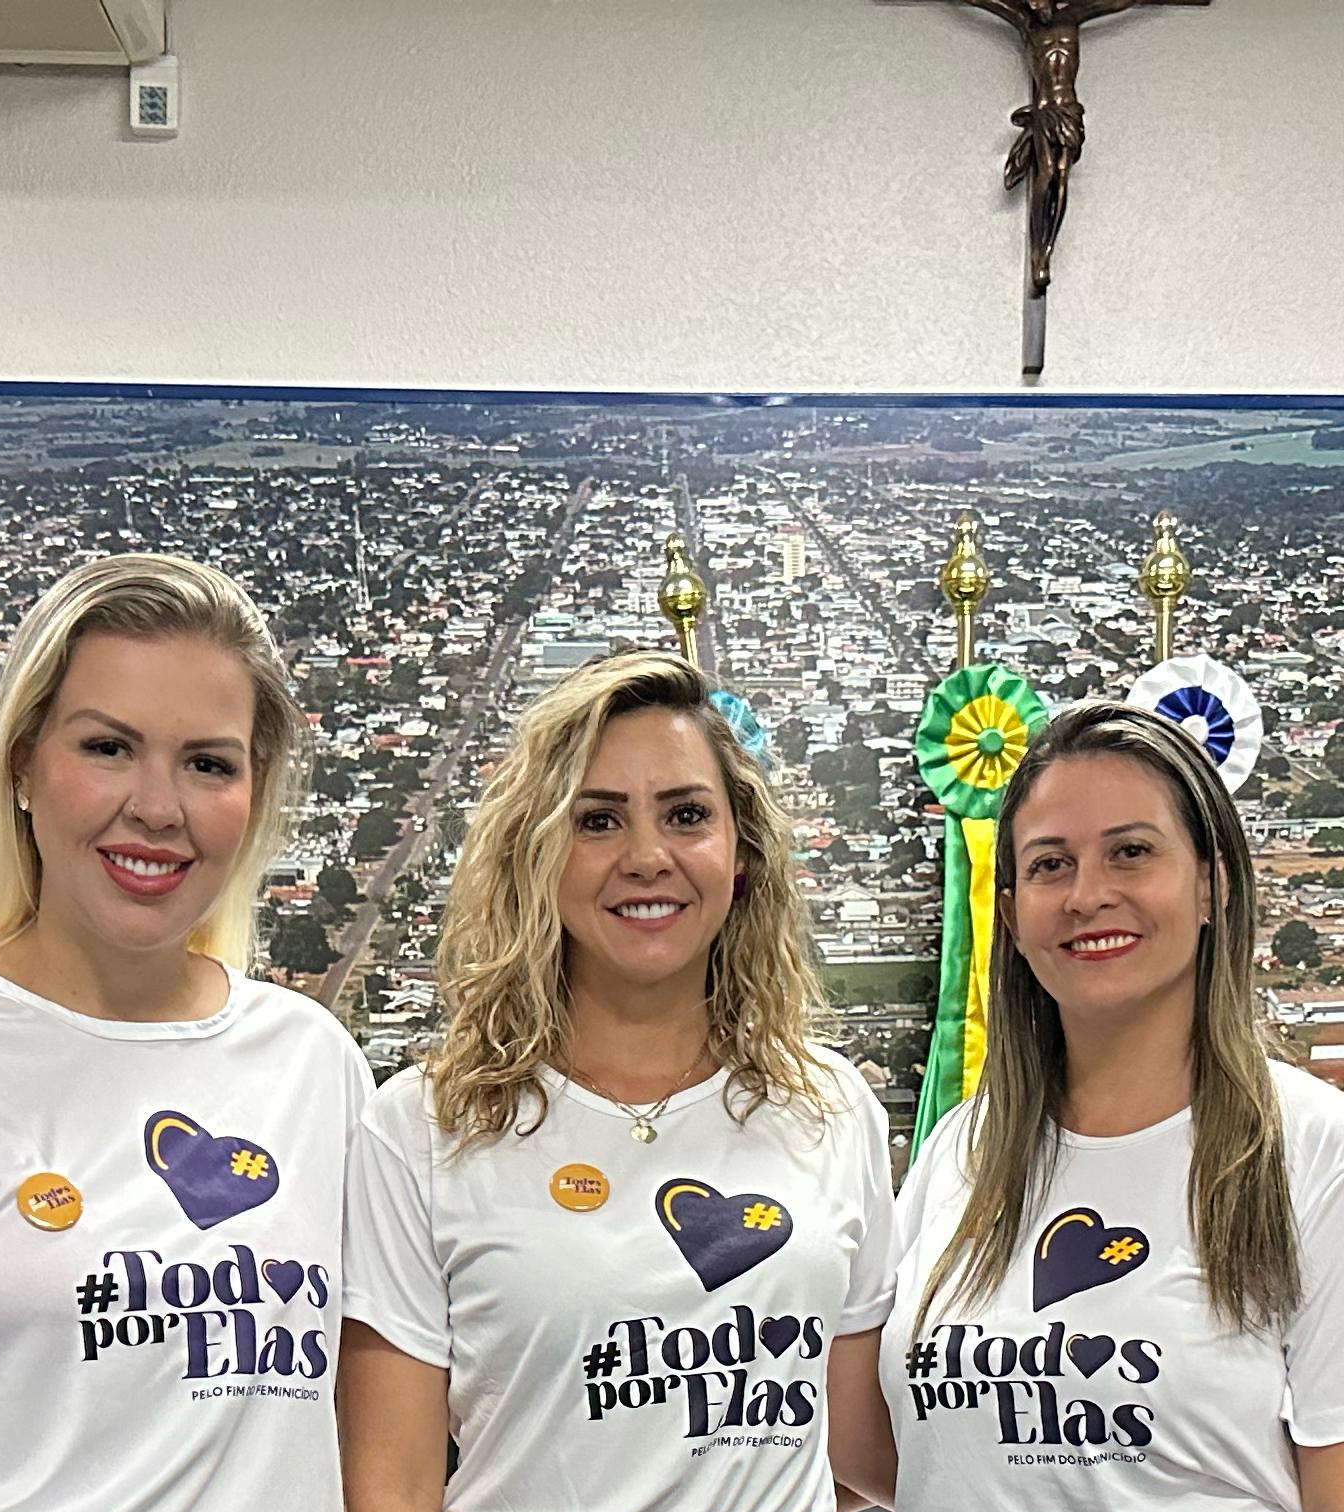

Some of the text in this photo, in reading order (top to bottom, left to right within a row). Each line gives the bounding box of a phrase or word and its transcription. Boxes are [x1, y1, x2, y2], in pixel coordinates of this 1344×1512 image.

[78, 1308, 329, 1381] por Elas
[191, 1386, 223, 1401] PELO
[226, 1386, 245, 1396] FIM
[584, 1368, 818, 1439] por Elas
[908, 1380, 1155, 1447] por Elas
[1007, 1454, 1034, 1465] PELO
[1036, 1454, 1056, 1465] FIM
[1058, 1454, 1076, 1465] DO
